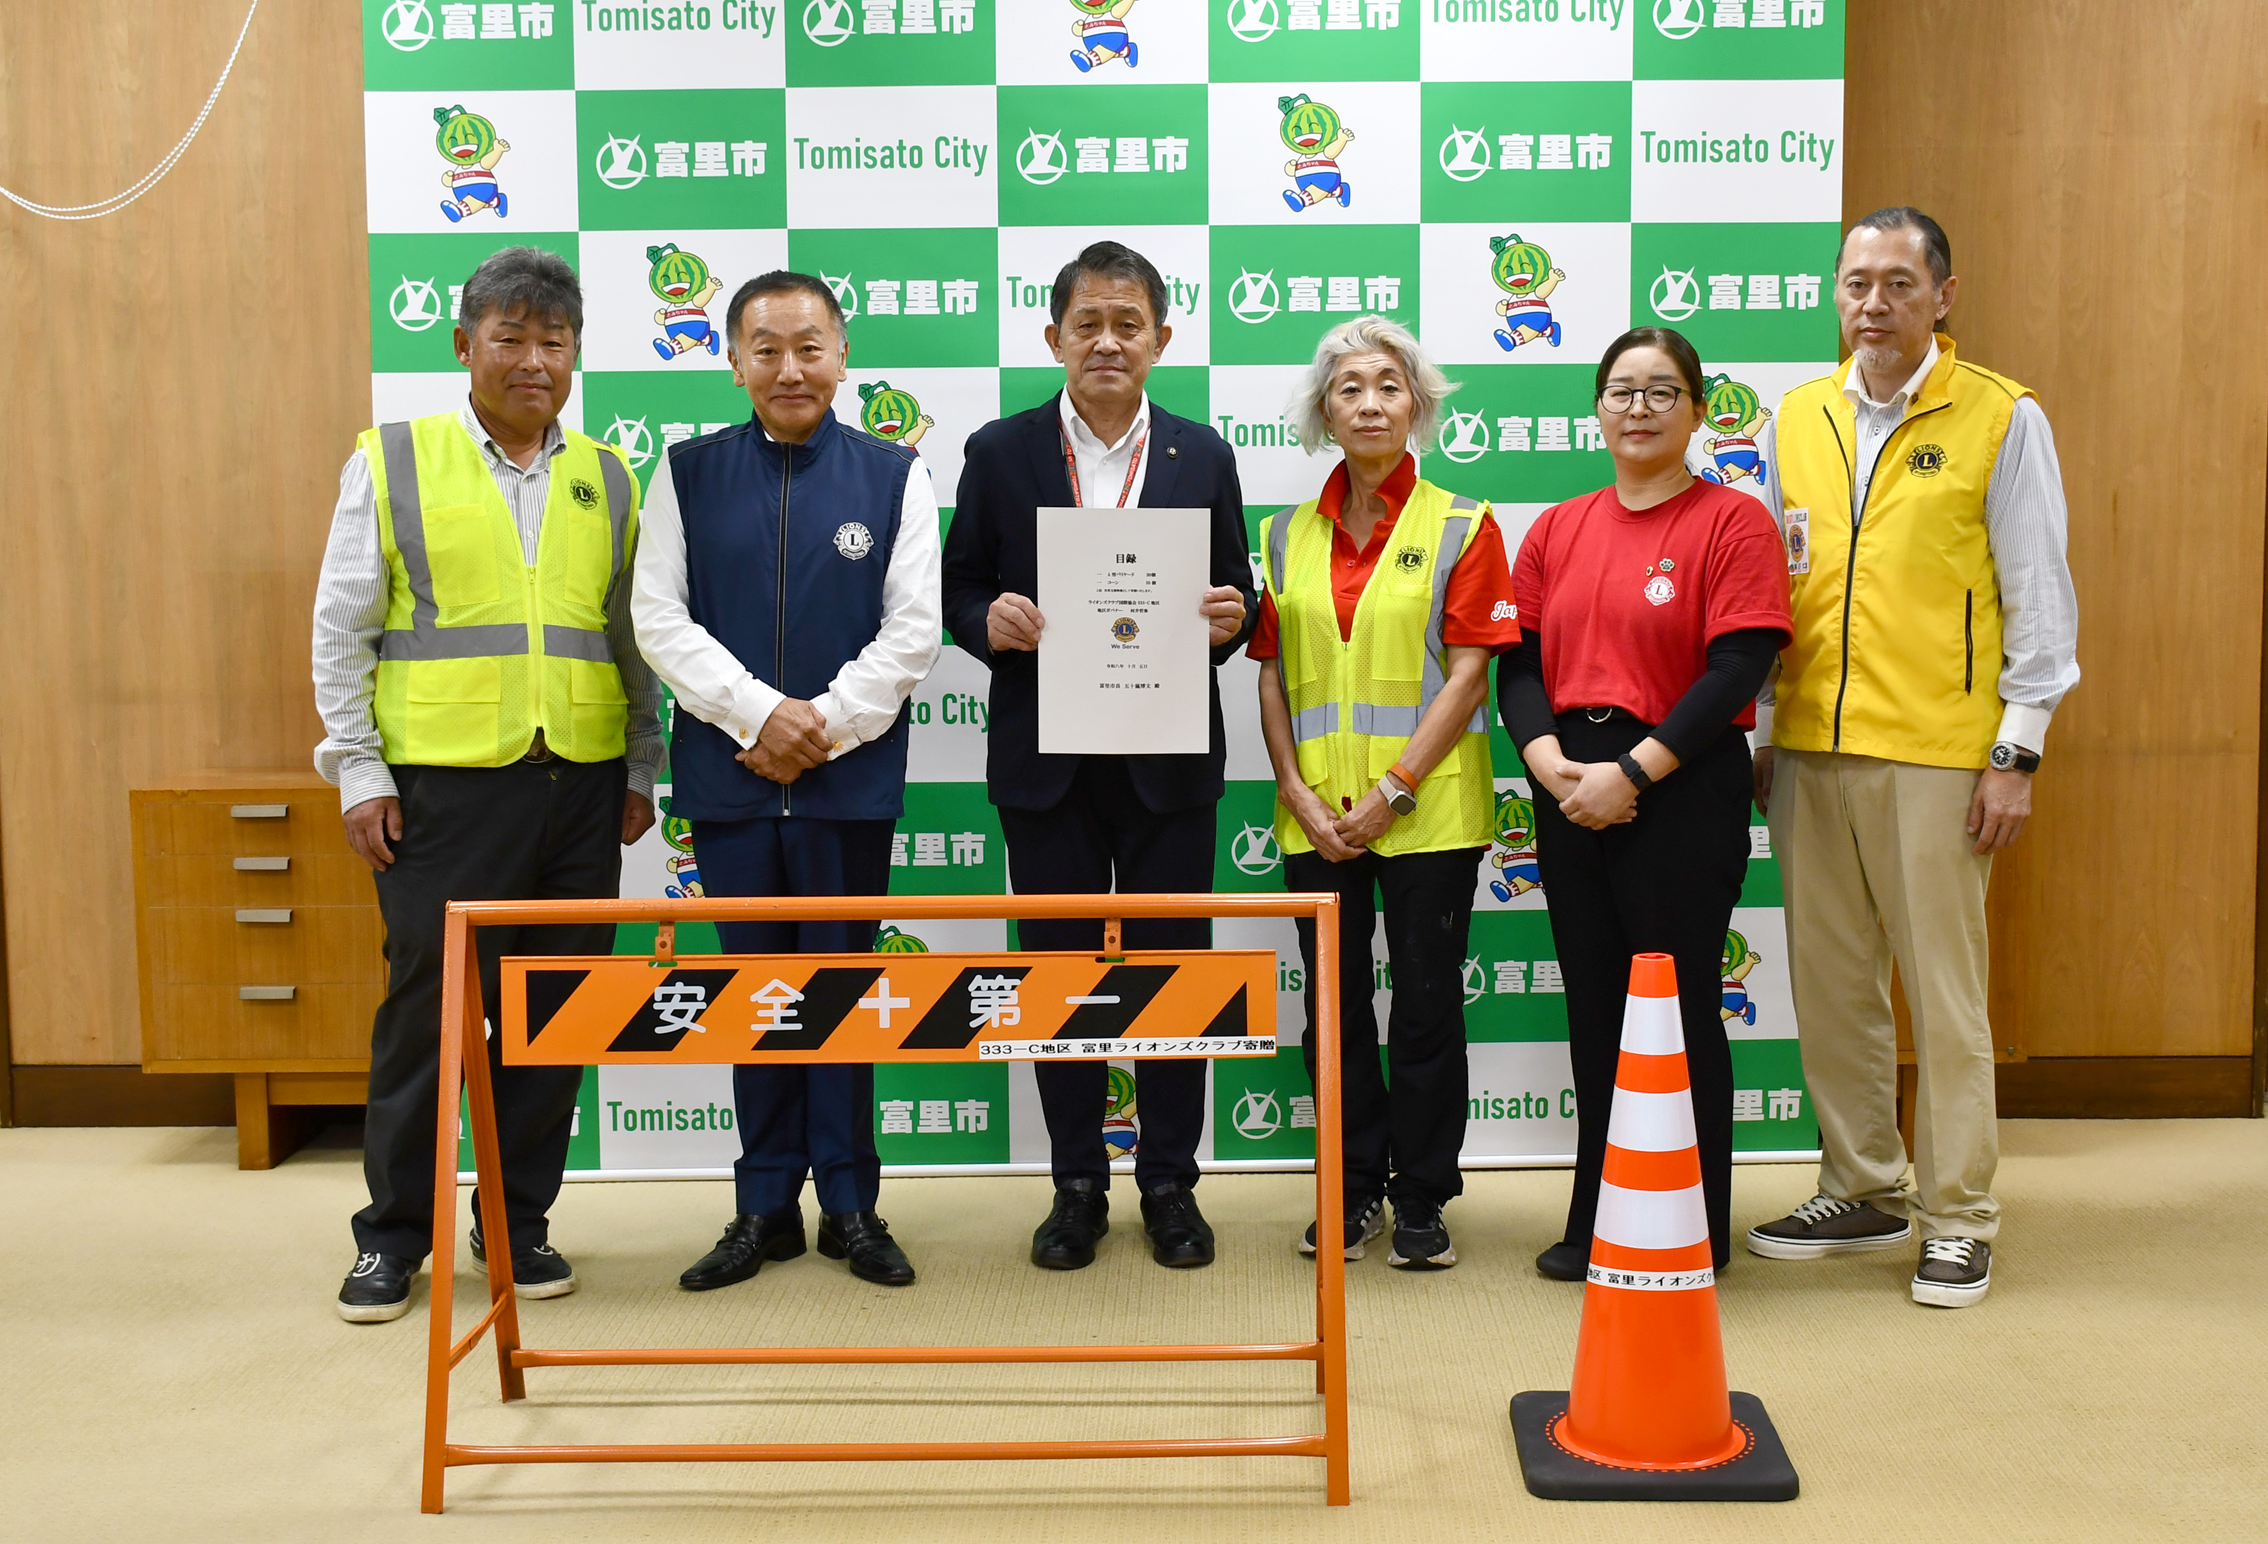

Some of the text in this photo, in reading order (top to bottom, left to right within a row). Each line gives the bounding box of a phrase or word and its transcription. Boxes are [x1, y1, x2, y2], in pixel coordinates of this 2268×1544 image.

[442, 2, 554, 40] 富里市
[581, 0, 776, 39] Tomisato City
[862, 0, 976, 35] 富里市
[1287, 0, 1401, 31] 富里市
[1433, 0, 1625, 31] Tomisato City
[1713, 0, 1826, 28] 富里市
[654, 139, 768, 178] 富里市
[794, 135, 988, 177] Tomisato City
[1075, 134, 1189, 174] 富里市
[1498, 132, 1612, 171] 富里市
[1640, 129, 1835, 171] Tomisato City
[865, 279, 979, 316] 富里市
[1166, 274, 1201, 315] ity
[1287, 275, 1401, 312] 富里市
[1709, 273, 1822, 311] 富里市
[1217, 415, 1301, 447] Tomis
[1497, 415, 1608, 452] 富里市
[1922, 454, 1933, 467] L
[850, 533, 860, 547] L
[1116, 553, 1137, 564] 目録
[942, 693, 989, 733] City
[1493, 959, 1566, 994] 富里
[1081, 1039, 1275, 1054] 富里ライオンズクラブ寄贈
[606, 1101, 734, 1131] Tomisato
[879, 1099, 989, 1134] 富里市
[1468, 1089, 1549, 1120] isato
[1733, 1088, 1802, 1122] 里市
